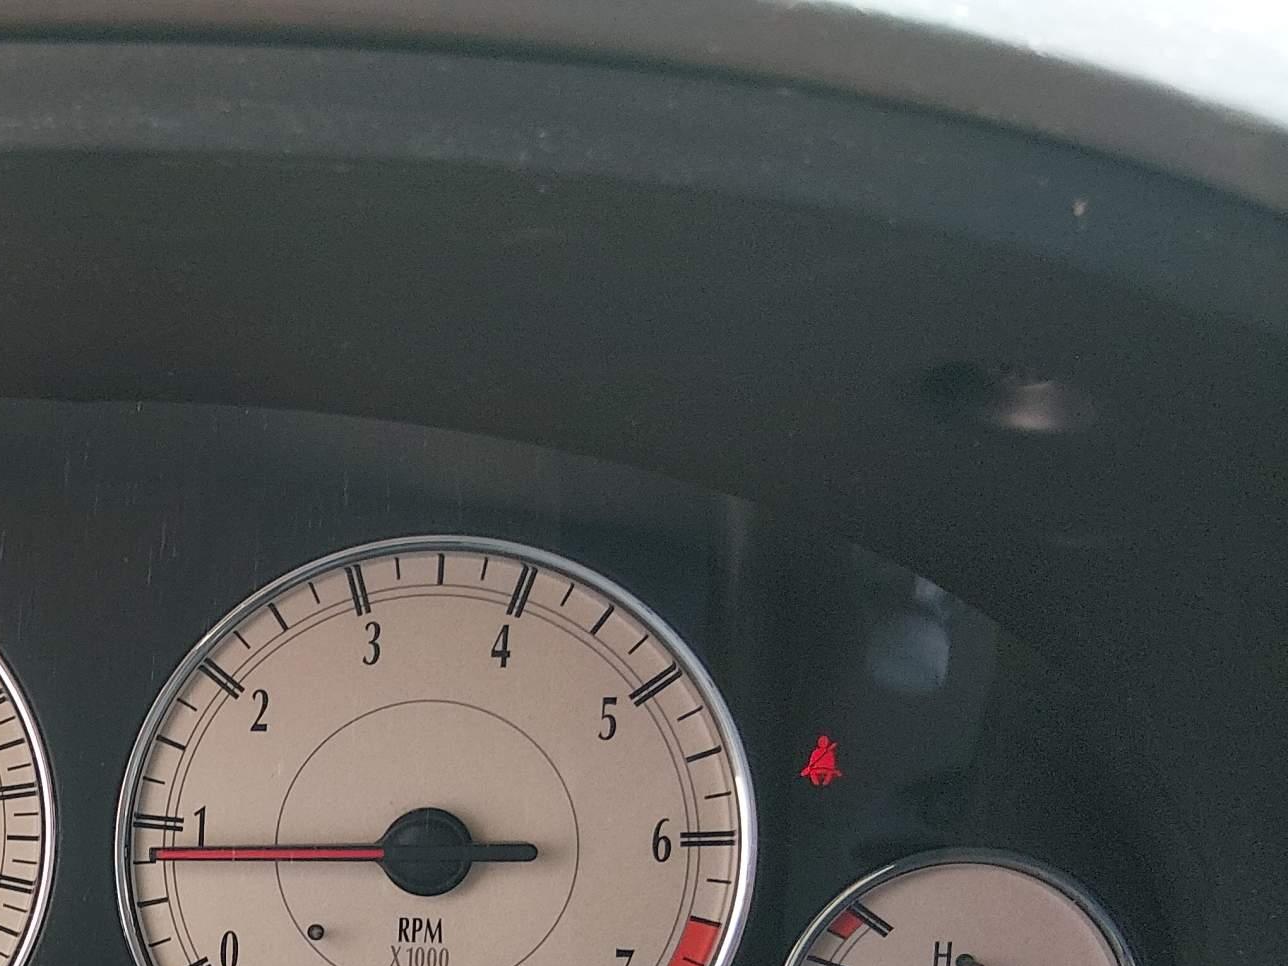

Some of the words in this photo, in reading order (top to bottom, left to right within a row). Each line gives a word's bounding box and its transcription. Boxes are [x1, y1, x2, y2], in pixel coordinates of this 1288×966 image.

[363, 622, 382, 665] 3
[491, 625, 511, 668] 4
[250, 689, 270, 732] 2
[598, 697, 618, 740] 5
[652, 818, 672, 862] 6
[398, 917, 444, 944] RPM
